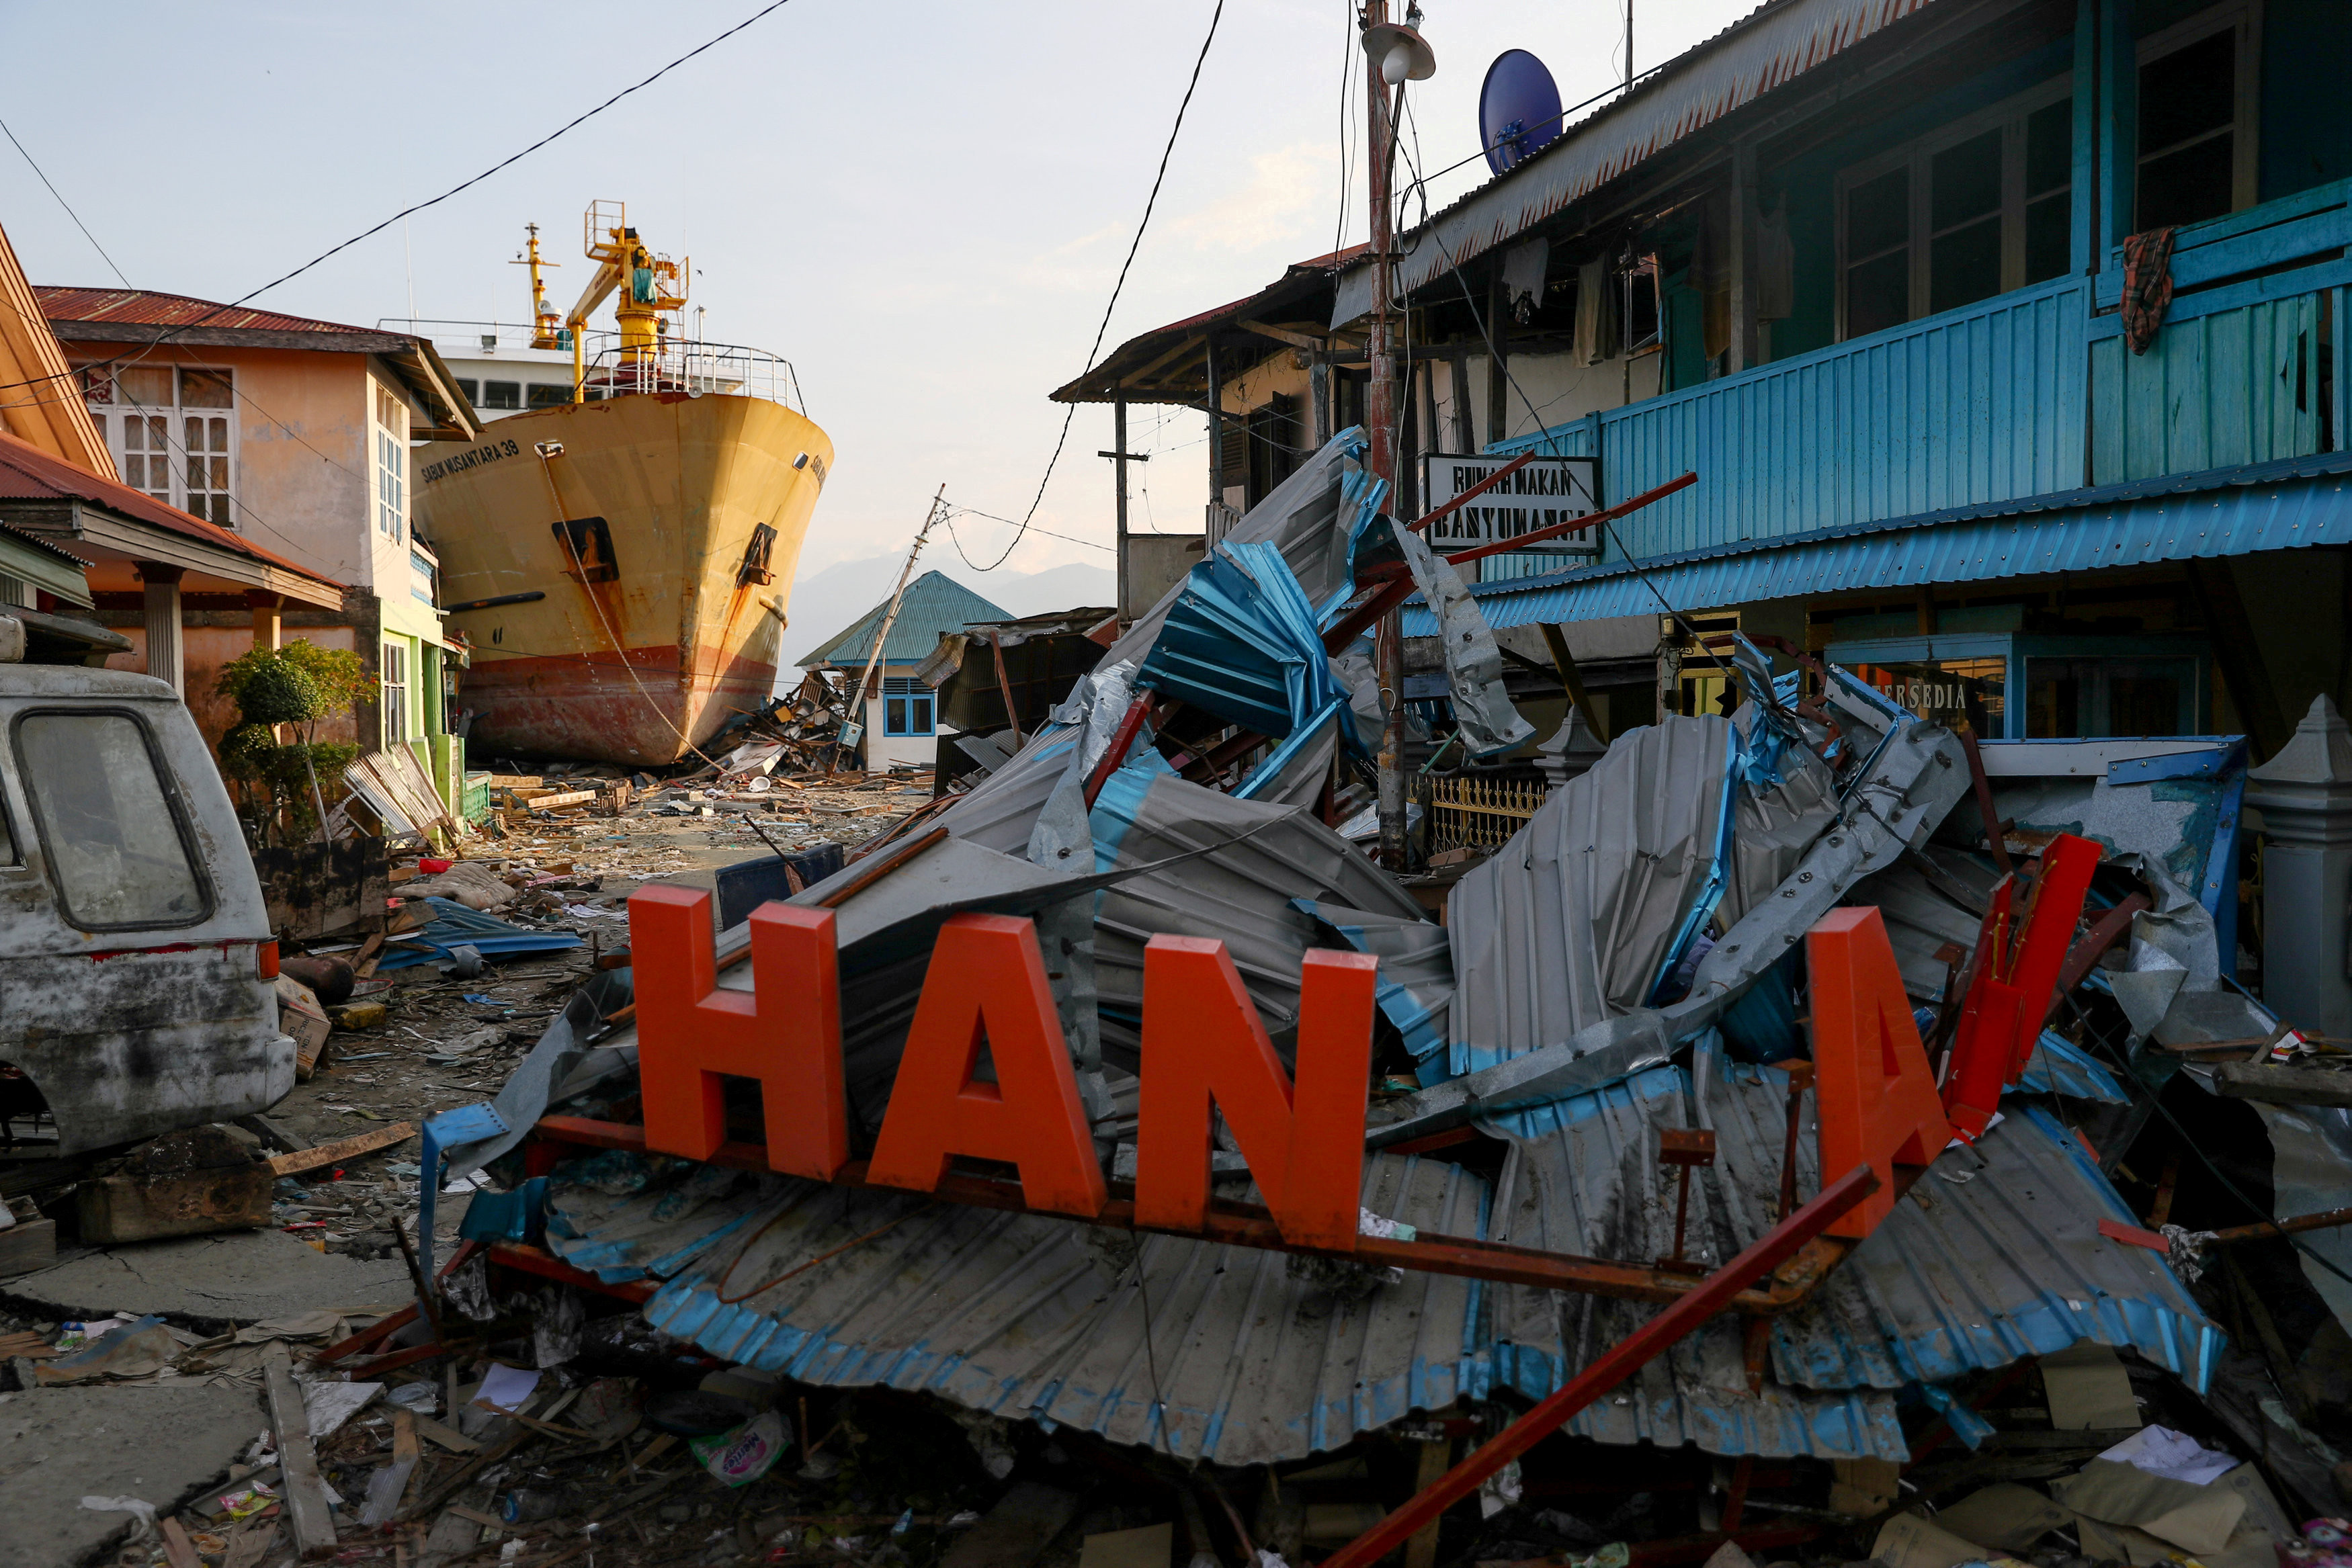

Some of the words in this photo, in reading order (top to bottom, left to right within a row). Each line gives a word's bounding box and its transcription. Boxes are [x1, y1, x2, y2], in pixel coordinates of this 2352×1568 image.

[421, 462, 448, 484] SABUK
[444, 445, 503, 474] NUSANTARA
[501, 439, 519, 457] 39
[1515, 467, 1571, 496] MAKAN
[722, 1432, 760, 1473] Merries
